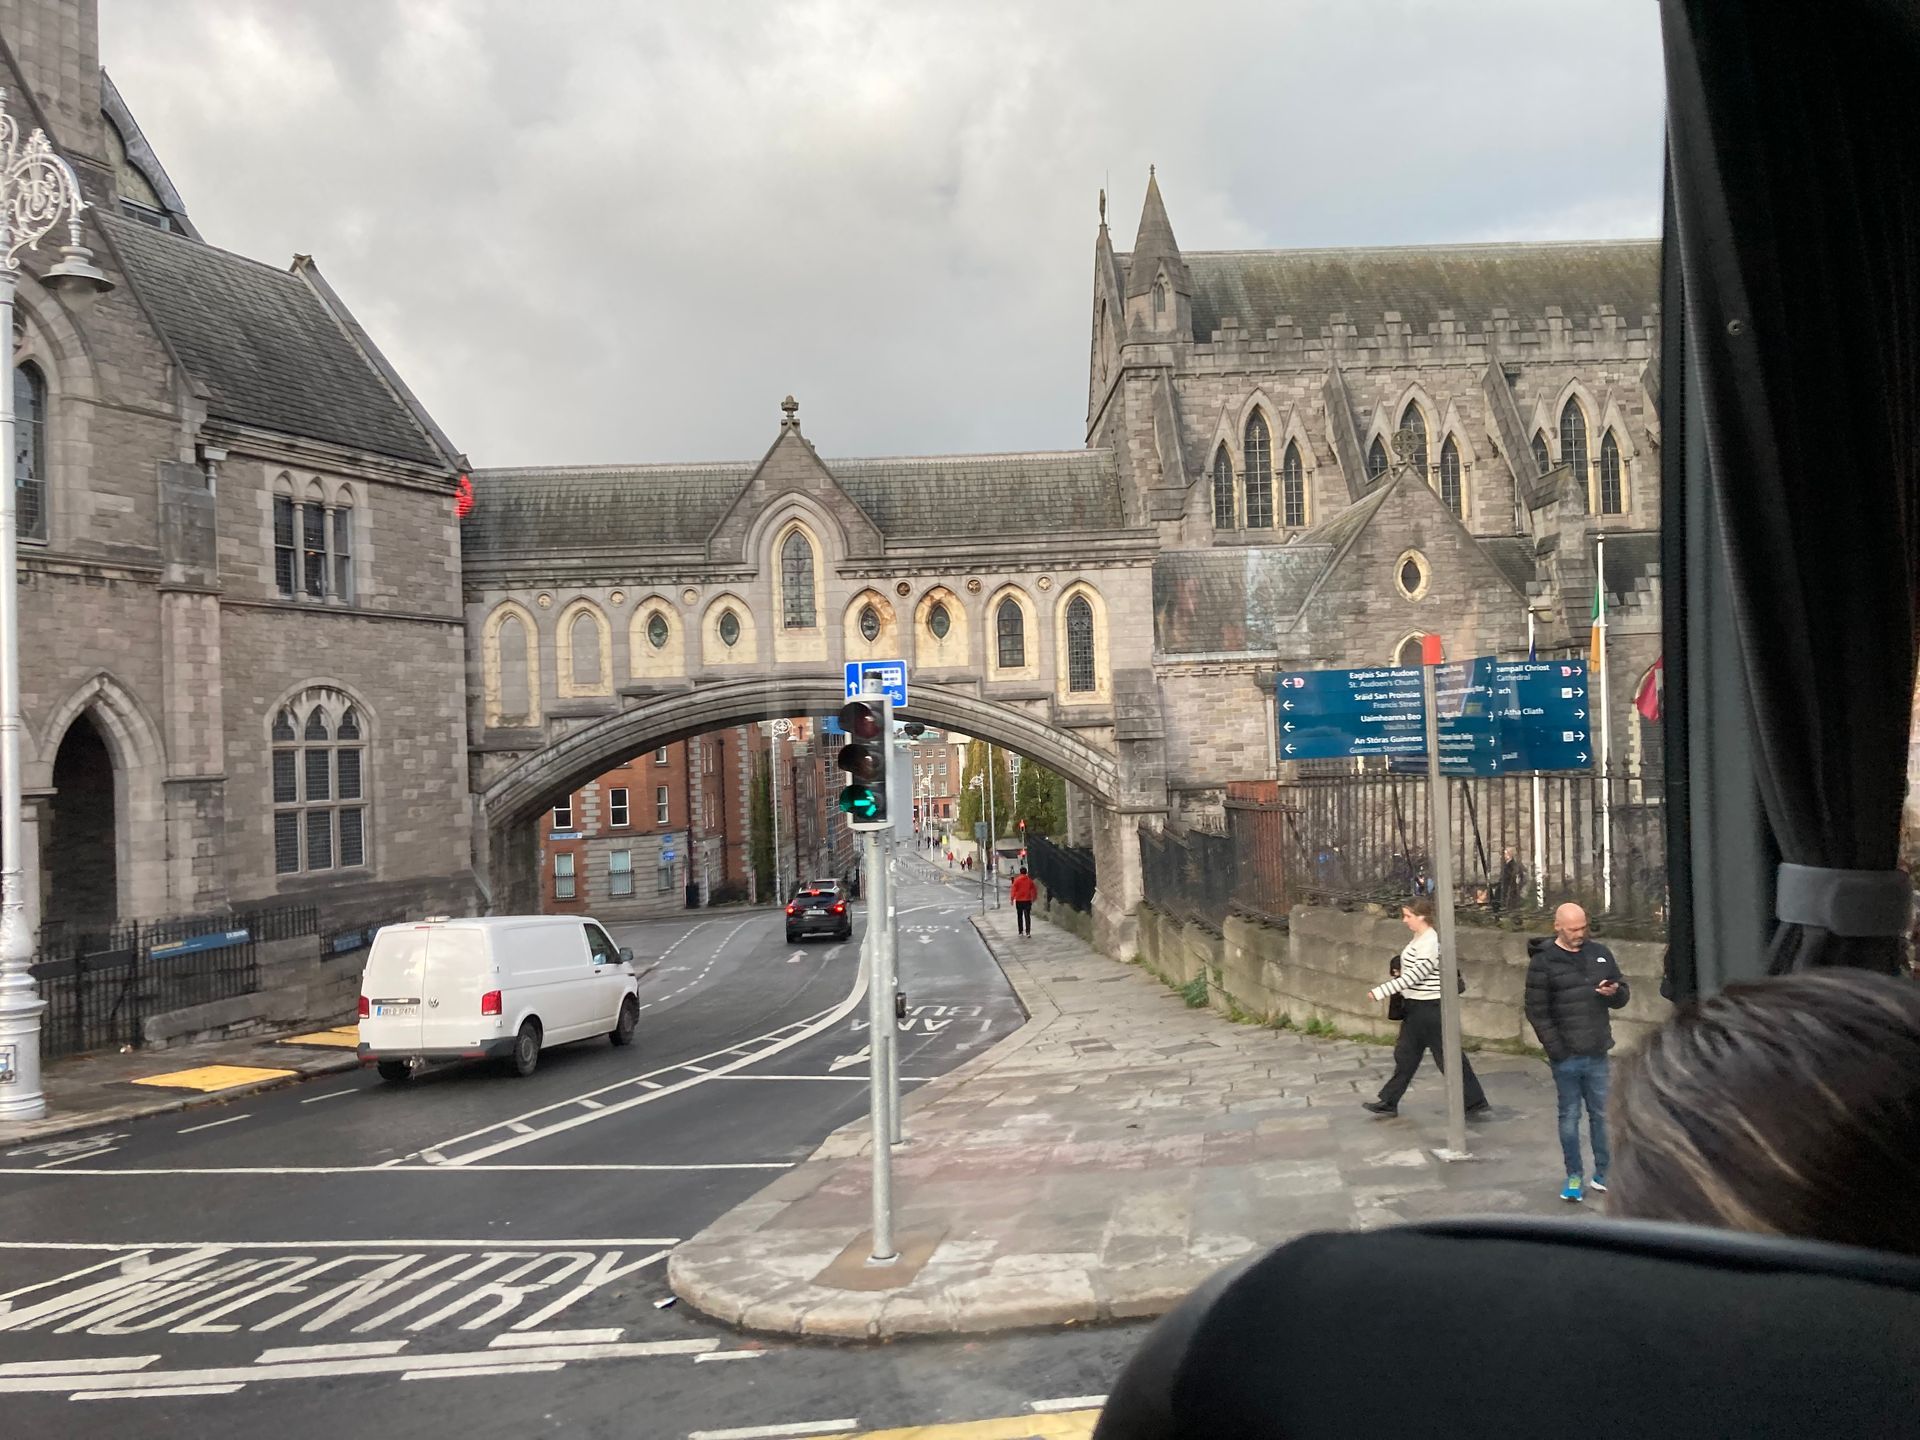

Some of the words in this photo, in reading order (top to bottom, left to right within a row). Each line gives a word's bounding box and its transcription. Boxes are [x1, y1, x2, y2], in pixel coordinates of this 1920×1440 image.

[1349, 672, 1374, 680] Eaglais
[905, 1005, 982, 1017] BU
[169, 1249, 673, 1334] ENTRY
